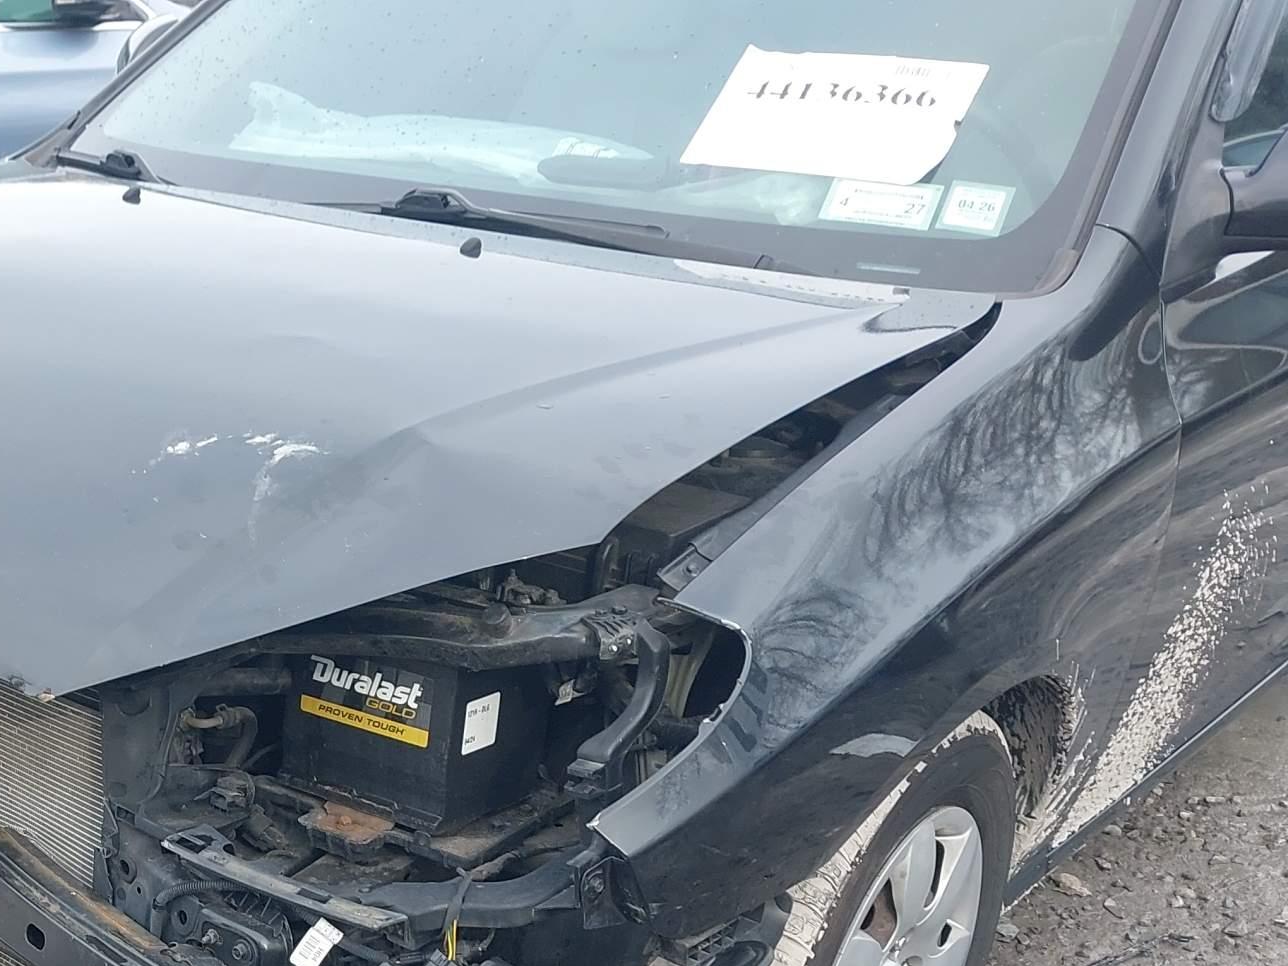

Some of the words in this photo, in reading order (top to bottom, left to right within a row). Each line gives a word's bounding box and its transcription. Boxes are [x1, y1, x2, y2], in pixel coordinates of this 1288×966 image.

[747, 80, 937, 107] 44136366
[904, 202, 926, 216] 27
[310, 654, 422, 710] Duralast
[317, 703, 364, 724] PROVEN
[366, 717, 405, 736] TOUGH
[365, 697, 417, 720] GOLD
